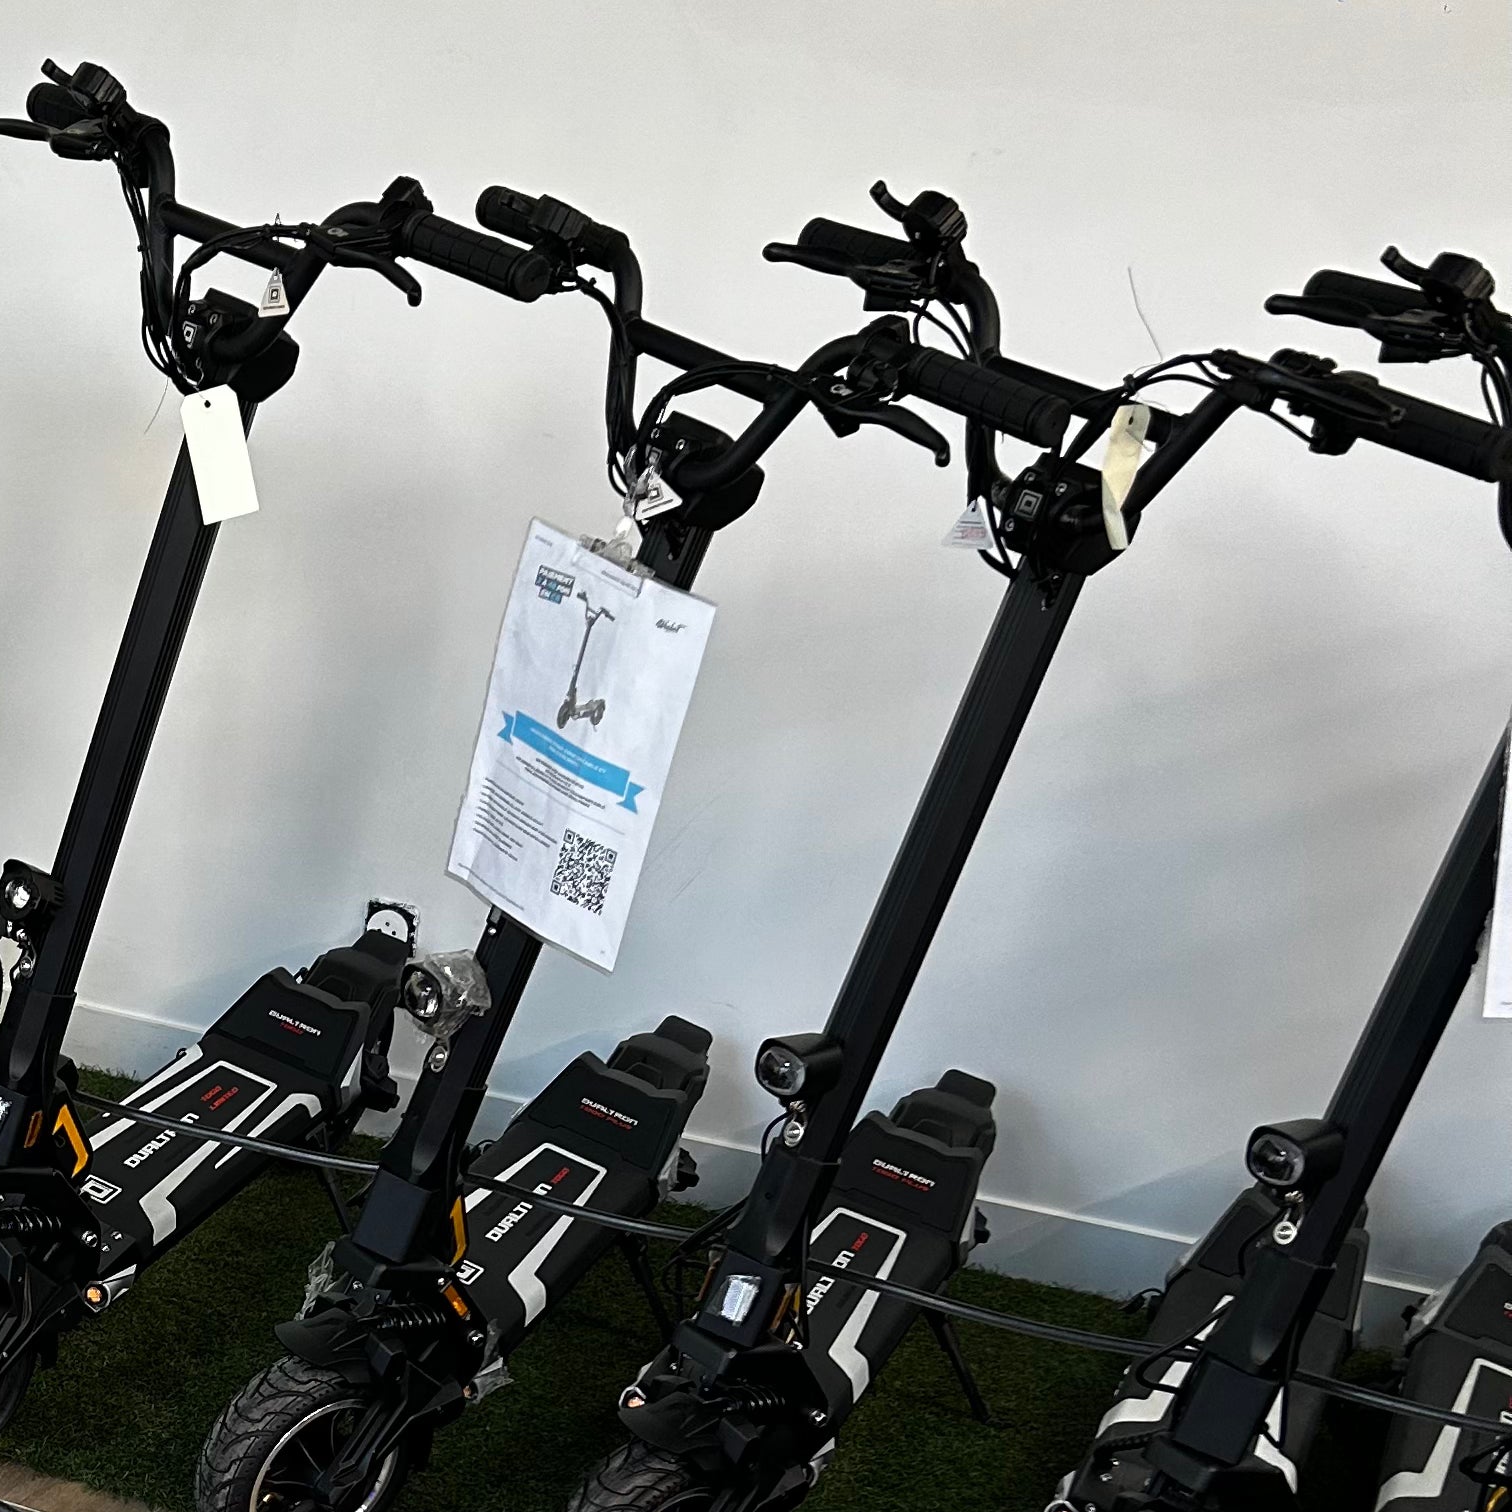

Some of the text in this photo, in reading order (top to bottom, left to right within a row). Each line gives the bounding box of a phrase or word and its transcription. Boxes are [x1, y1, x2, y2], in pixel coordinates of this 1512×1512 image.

[268, 1009, 322, 1036] DUALTRON
[581, 1097, 639, 1126] DUALTRON
[872, 1158, 936, 1187] DUALTRON
